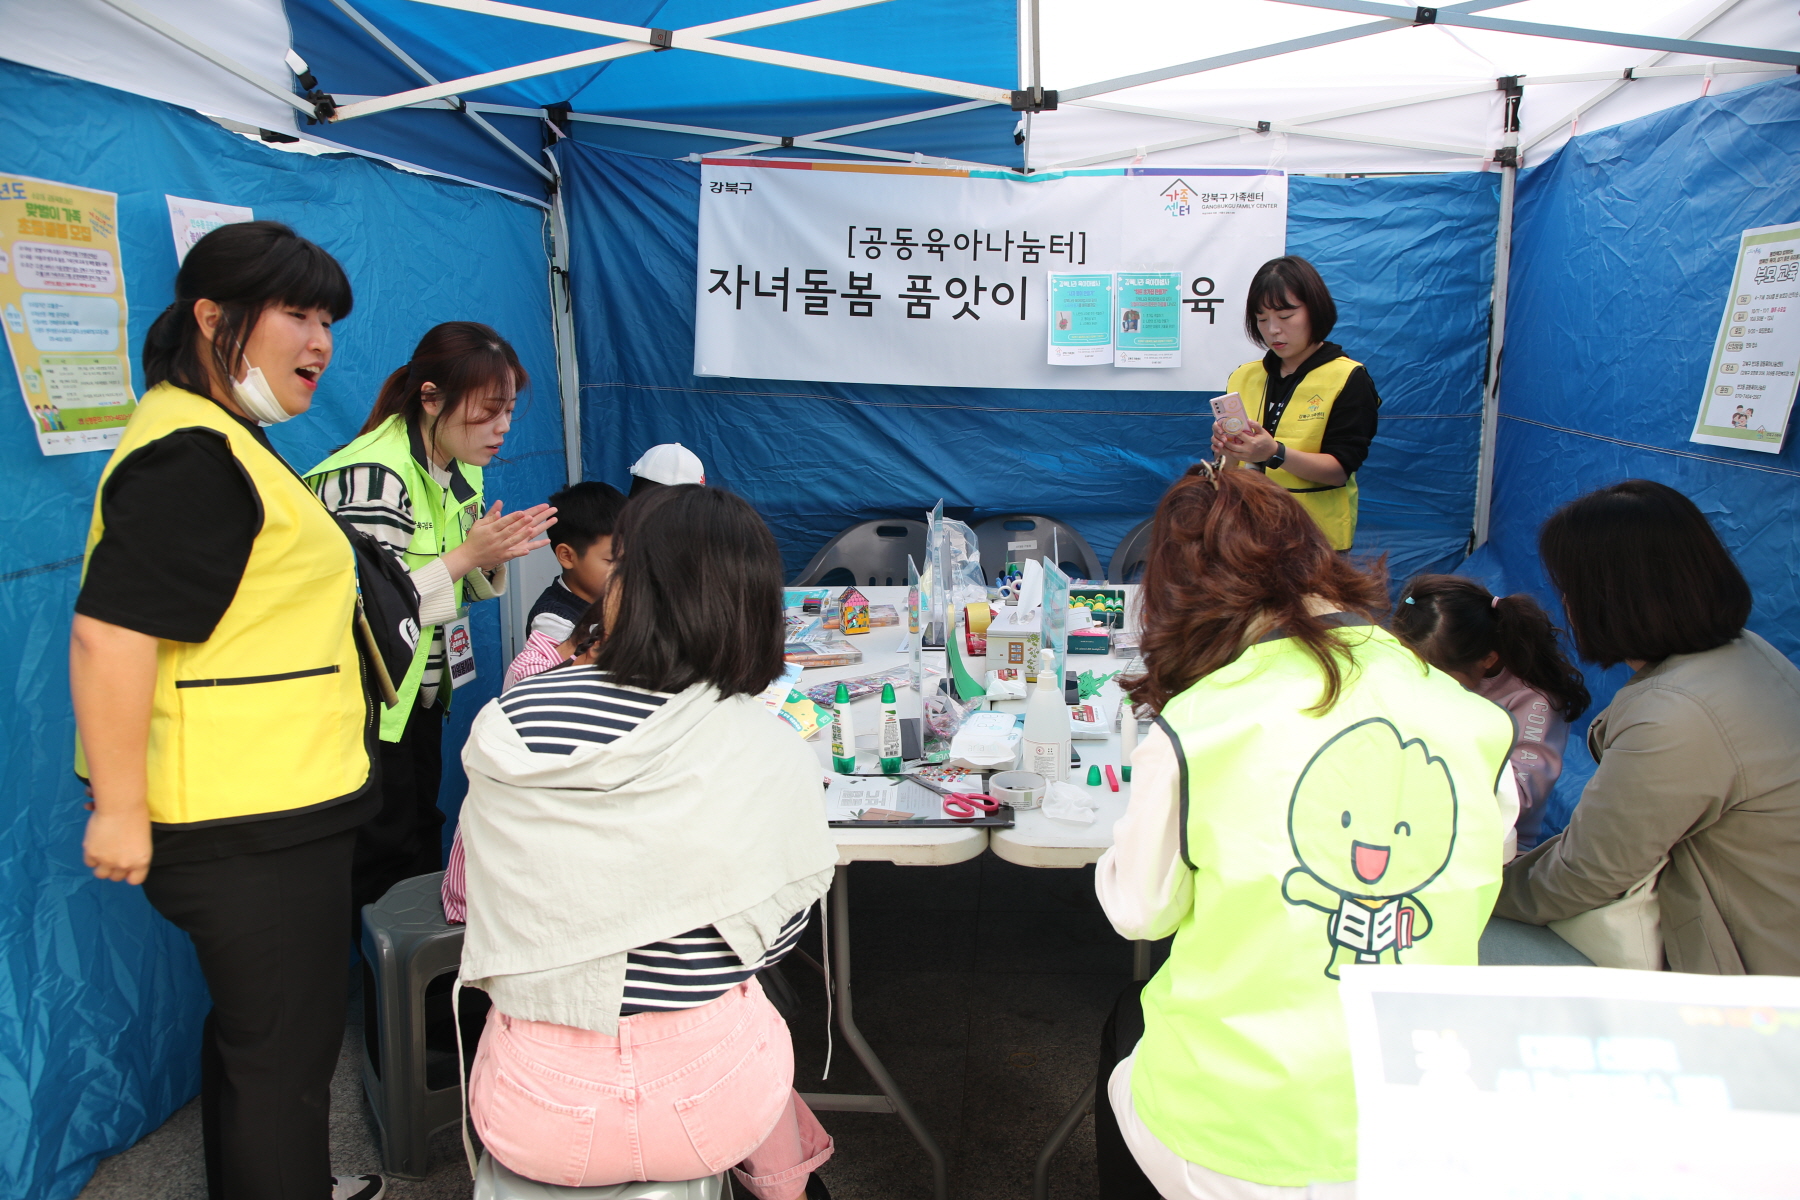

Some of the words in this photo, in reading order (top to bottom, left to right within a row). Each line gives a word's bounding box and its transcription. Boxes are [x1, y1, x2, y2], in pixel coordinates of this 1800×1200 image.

[709, 181, 753, 195] 강북구
[1201, 193, 1228, 202] 강북구
[1229, 192, 1264, 202] 가족센터
[25, 202, 60, 220] 맞벌이
[62, 206, 82, 224] 가족
[848, 226, 1086, 264] [공동육아나눔터]
[708, 264, 882, 318] 자녀돌봄
[898, 275, 1027, 321] 품앗이
